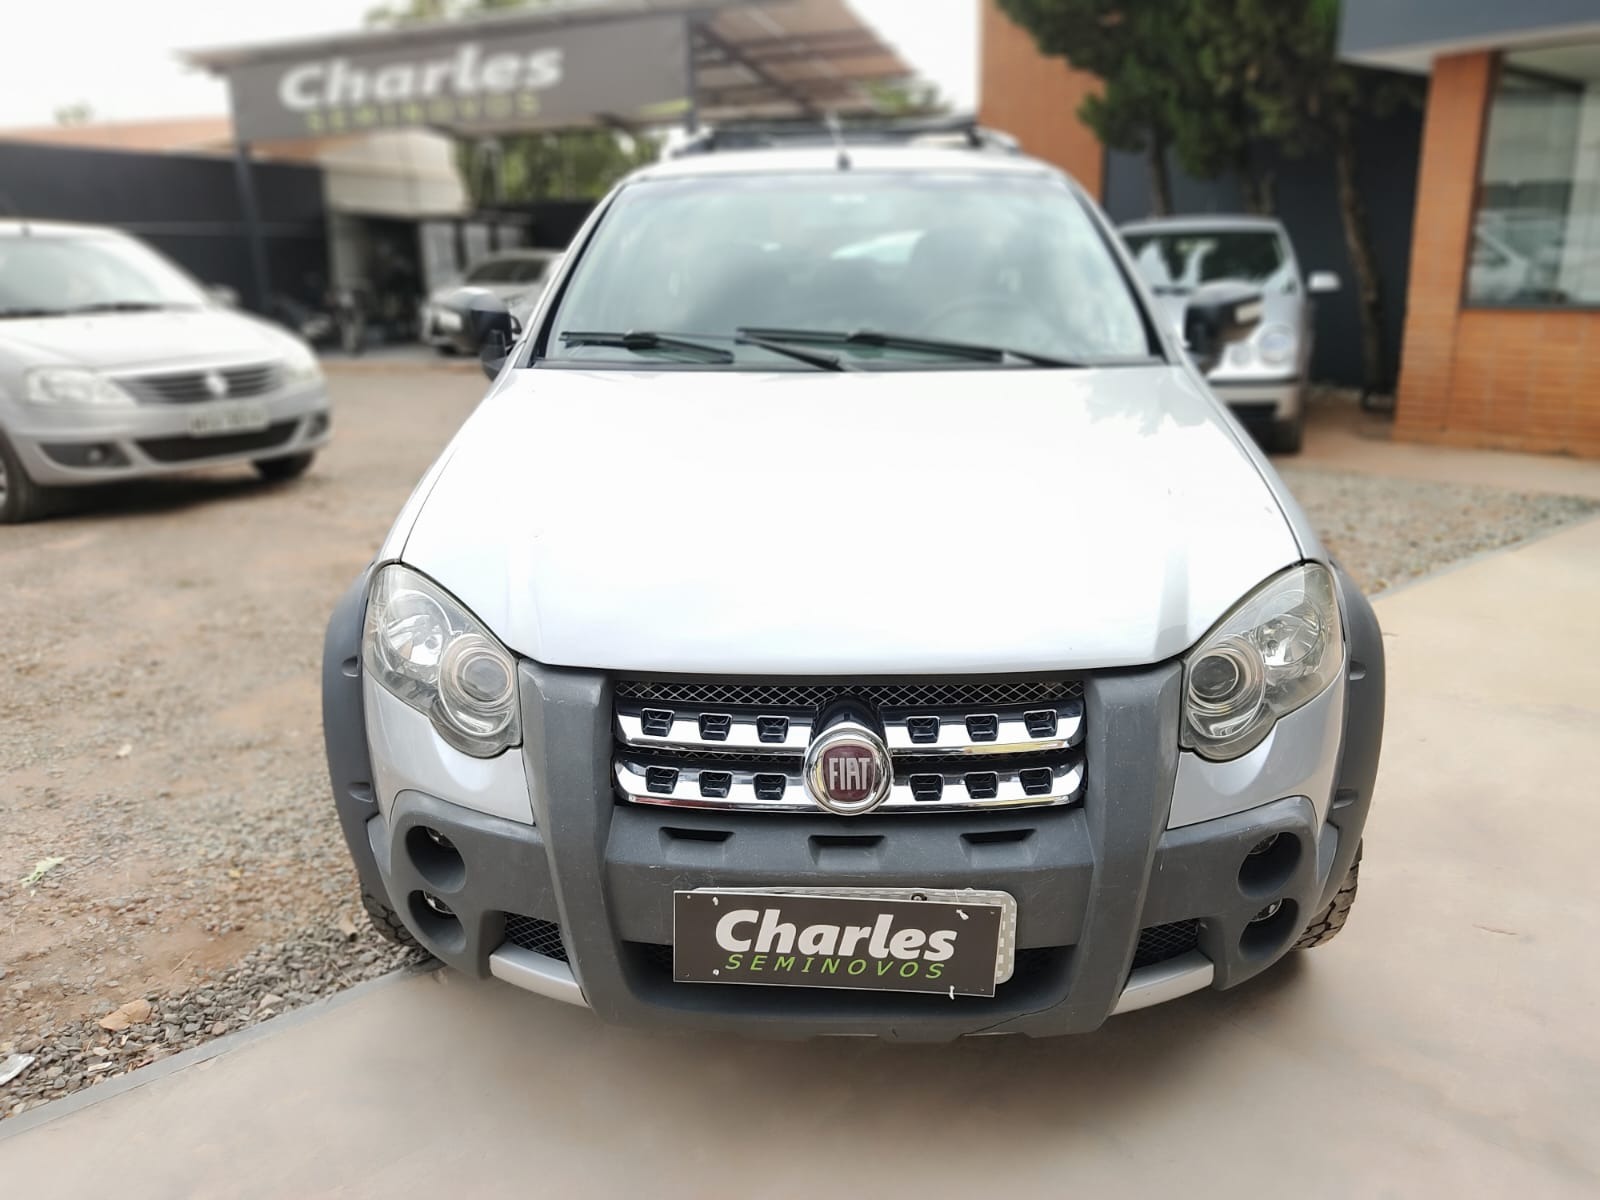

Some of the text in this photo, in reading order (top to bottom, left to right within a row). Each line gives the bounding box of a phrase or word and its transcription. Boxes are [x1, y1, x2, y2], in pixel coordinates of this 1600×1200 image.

[280, 45, 563, 110] Charles
[828, 757, 871, 791] FIAT
[715, 909, 957, 961] Charles
[725, 954, 945, 978] SEMINOVOS
